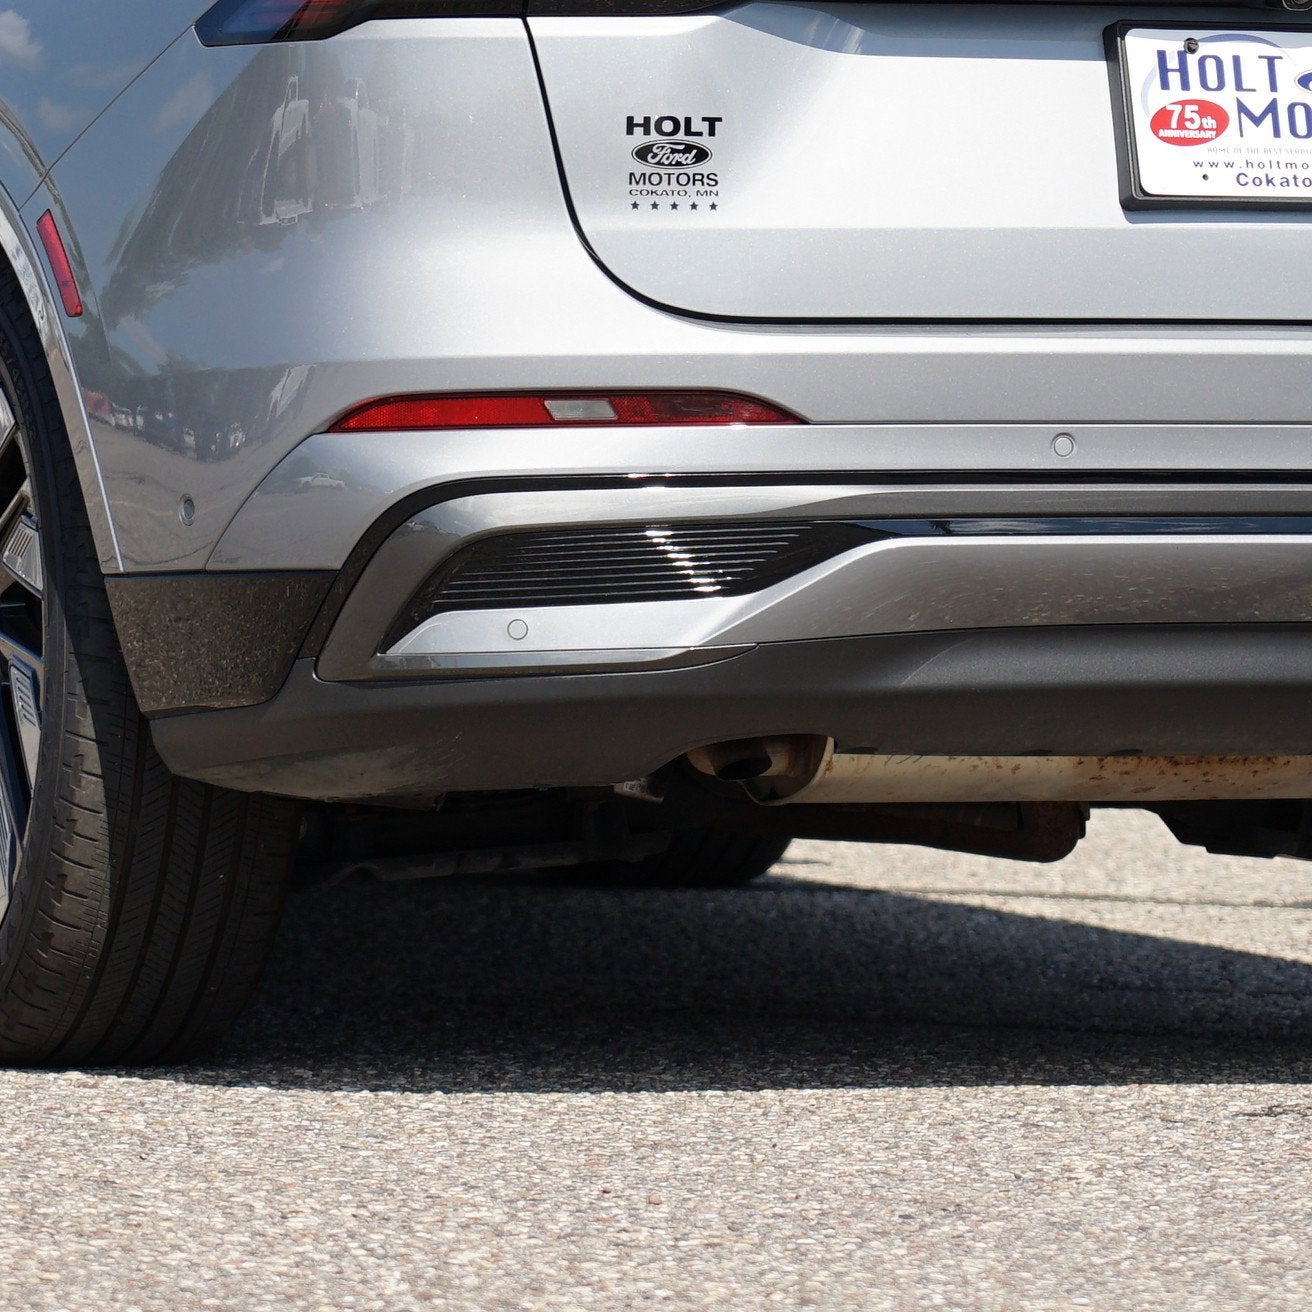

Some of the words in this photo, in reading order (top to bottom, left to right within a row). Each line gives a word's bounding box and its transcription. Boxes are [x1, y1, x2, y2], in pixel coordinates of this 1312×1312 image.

[1156, 49, 1284, 93] HOLT
[625, 115, 724, 138] HOLT
[1164, 103, 1218, 130] 75th
[1158, 128, 1217, 139] ANNIVERSARY
[646, 142, 698, 166] Ford
[628, 171, 719, 188] MOTORS
[628, 189, 691, 198] COKATO,
[695, 189, 719, 197] MN
